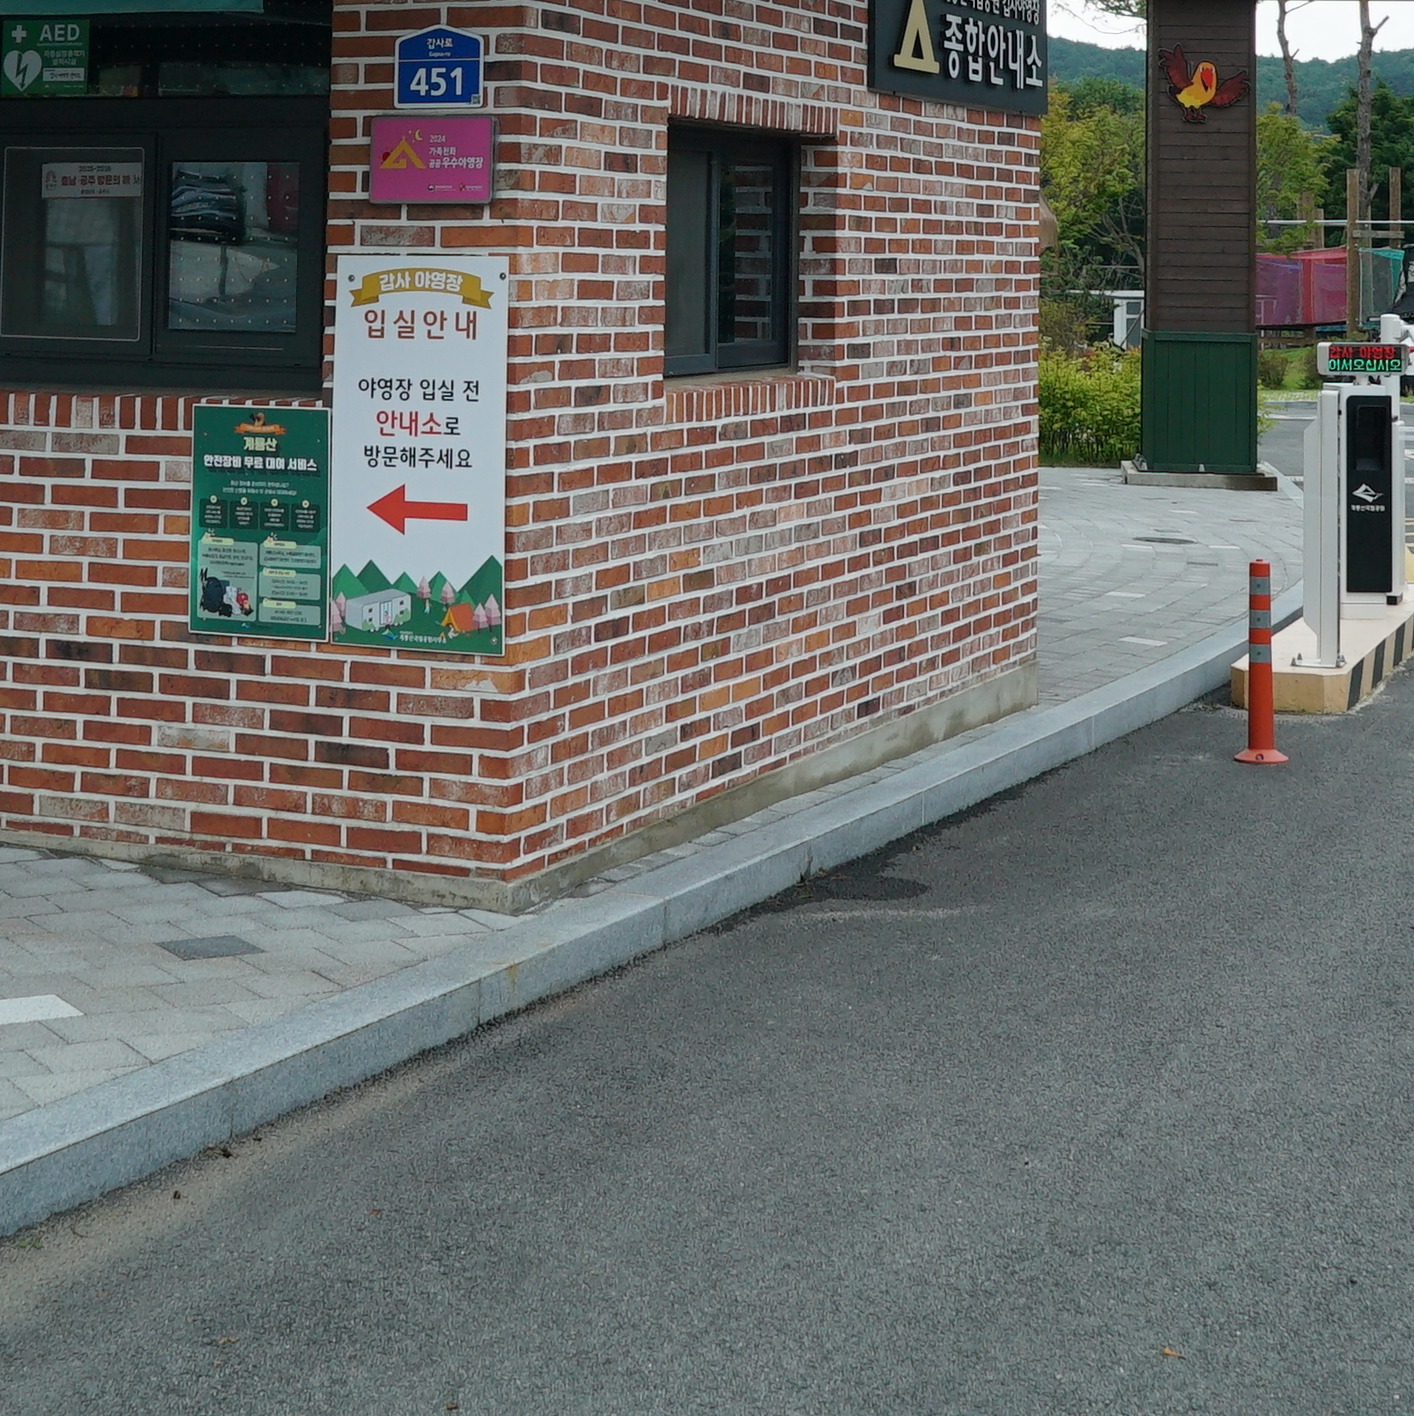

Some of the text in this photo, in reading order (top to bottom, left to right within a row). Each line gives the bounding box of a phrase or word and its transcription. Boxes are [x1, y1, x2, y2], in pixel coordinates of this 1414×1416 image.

[39, 23, 80, 42] AED
[426, 37, 453, 49] 갑사로
[943, 13, 1043, 90] 종합안내소
[409, 67, 463, 97] 451
[378, 270, 464, 293] 갑사 야영장
[1328, 359, 1401, 372] 어서오십시오
[358, 377, 480, 403] 야영장 입실 전
[376, 410, 461, 437] 안내소로
[243, 436, 278, 452] 계룡산
[244, 456, 264, 469] 무료
[266, 457, 285, 470] 대여
[287, 458, 318, 472] 서비스
[363, 444, 473, 470] 방문해주세요
